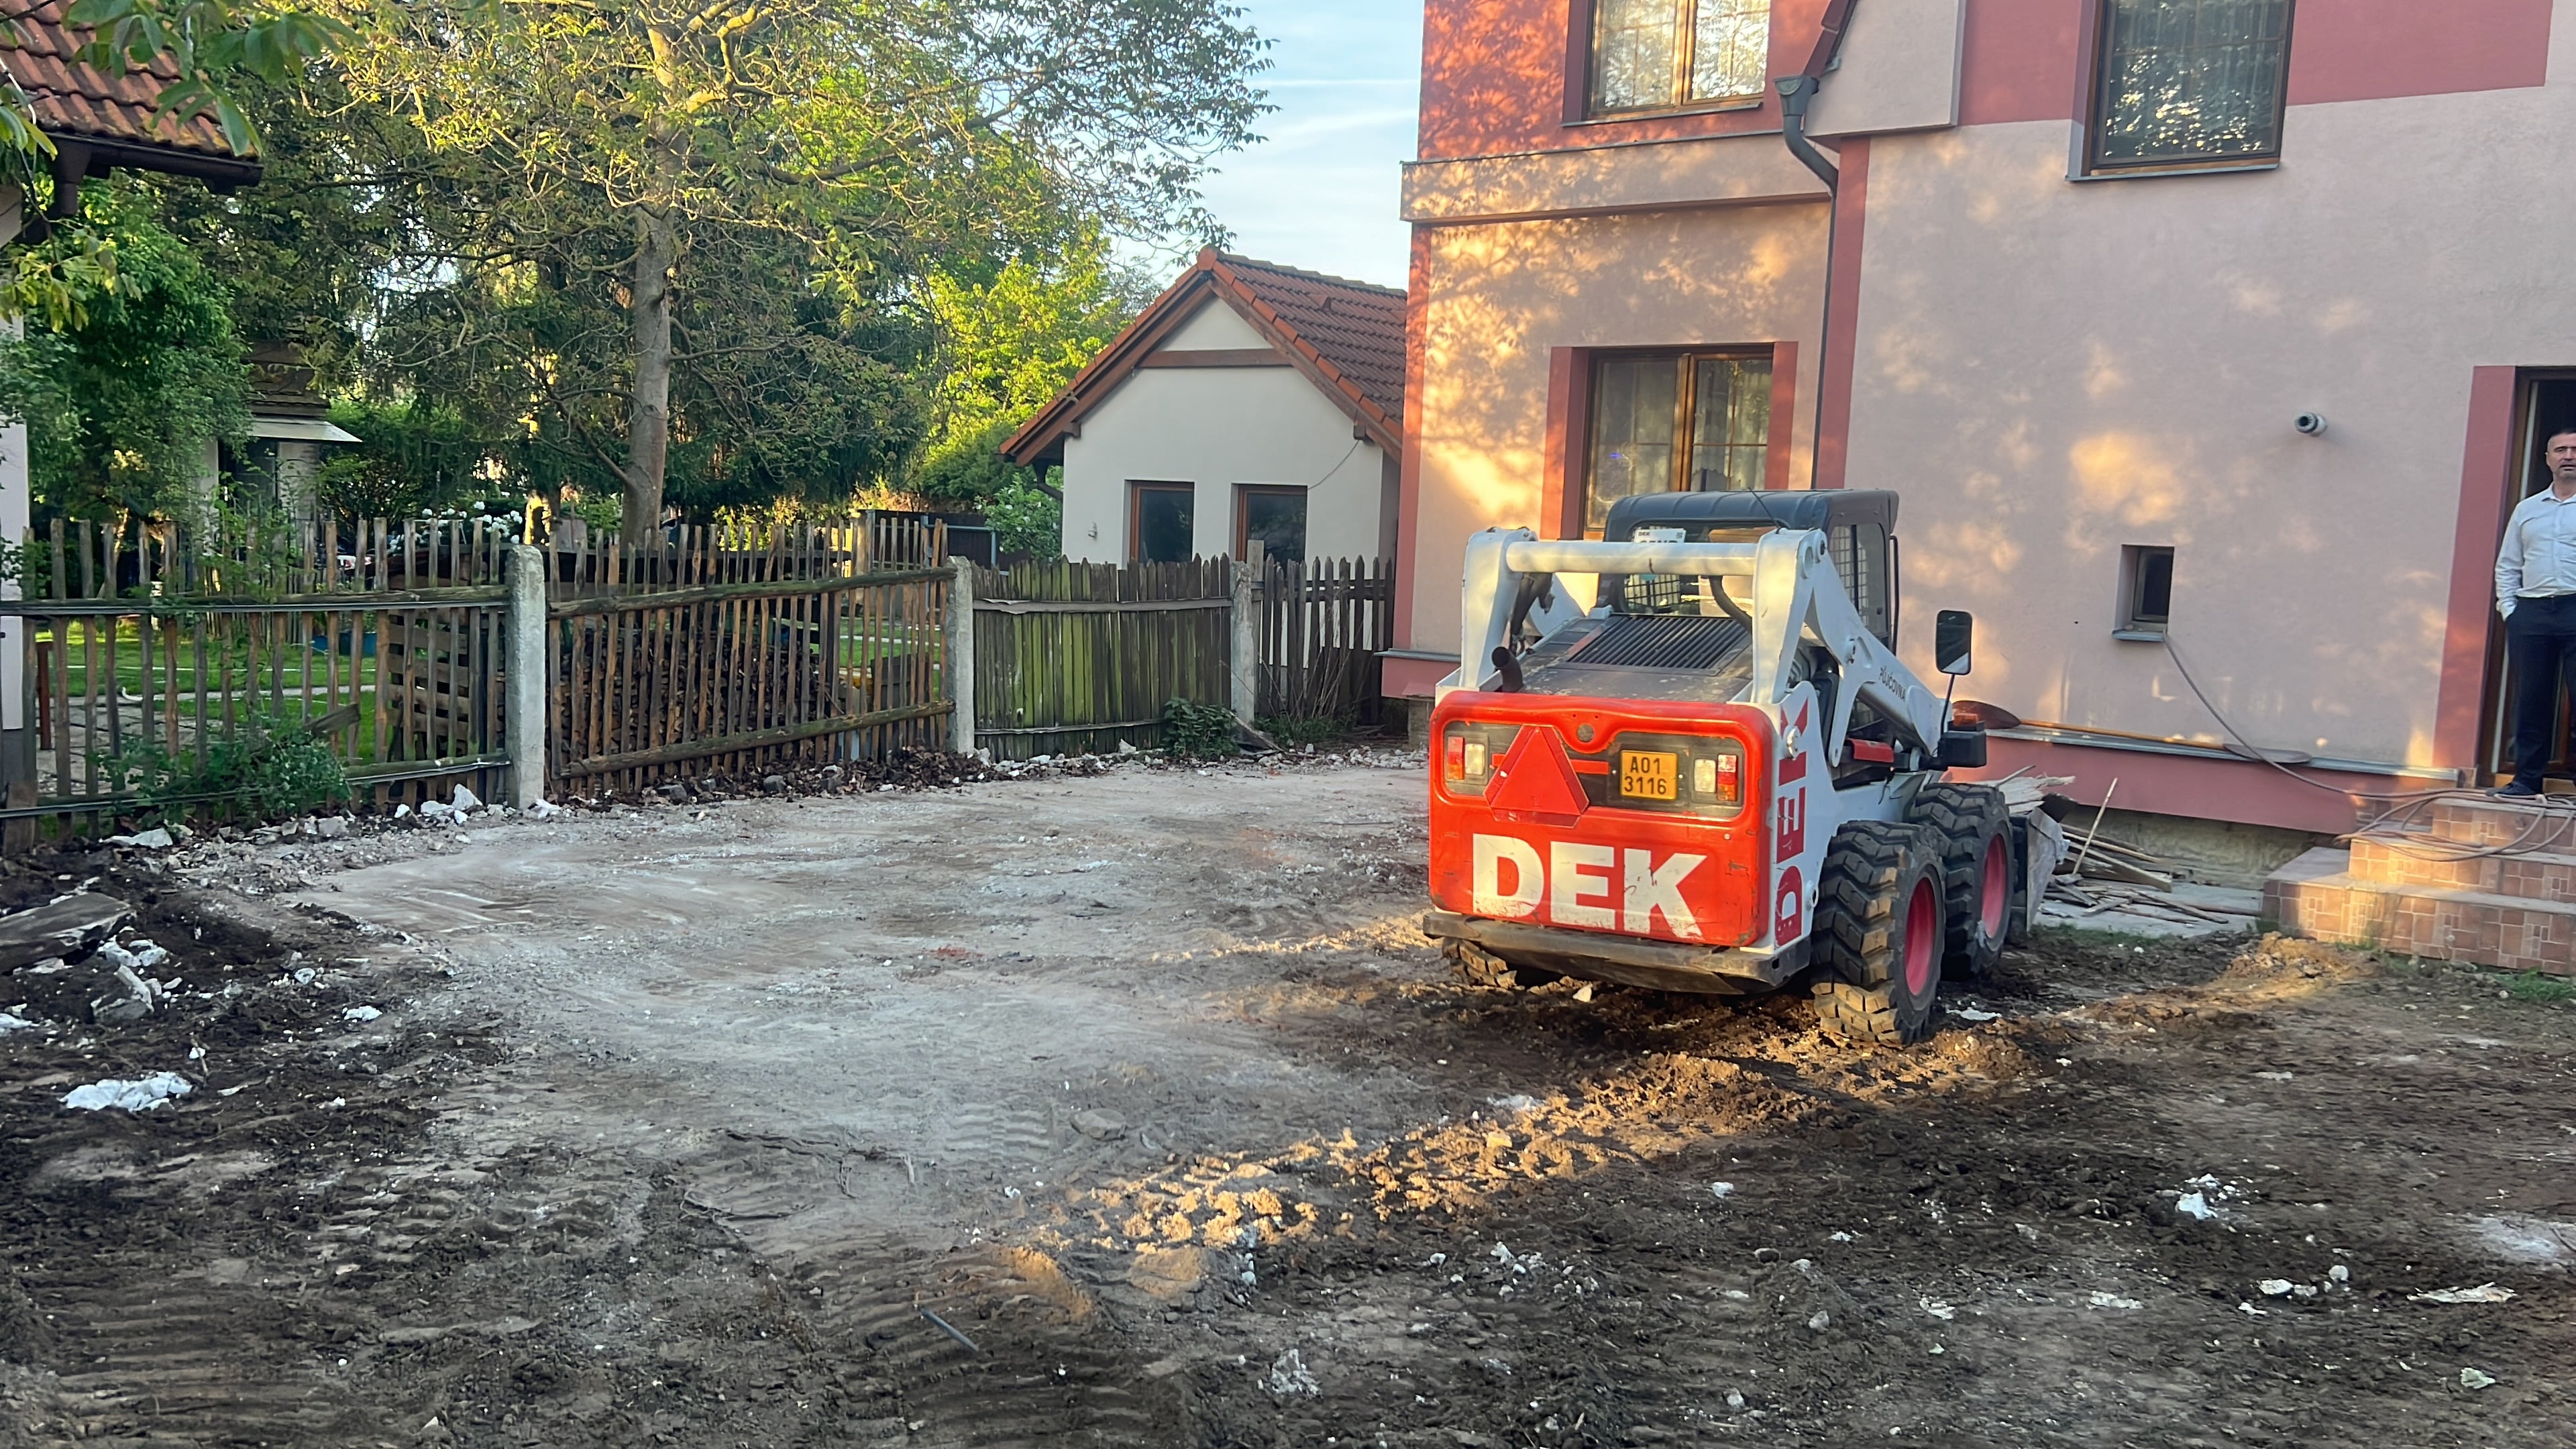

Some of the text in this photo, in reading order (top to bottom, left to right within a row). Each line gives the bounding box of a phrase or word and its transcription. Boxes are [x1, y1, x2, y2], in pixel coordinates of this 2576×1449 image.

[1624, 775, 1667, 795] 3116
[1630, 756, 1661, 774] A01
[1774, 697, 1809, 947] DEK
[1472, 833, 1708, 941] DEK
